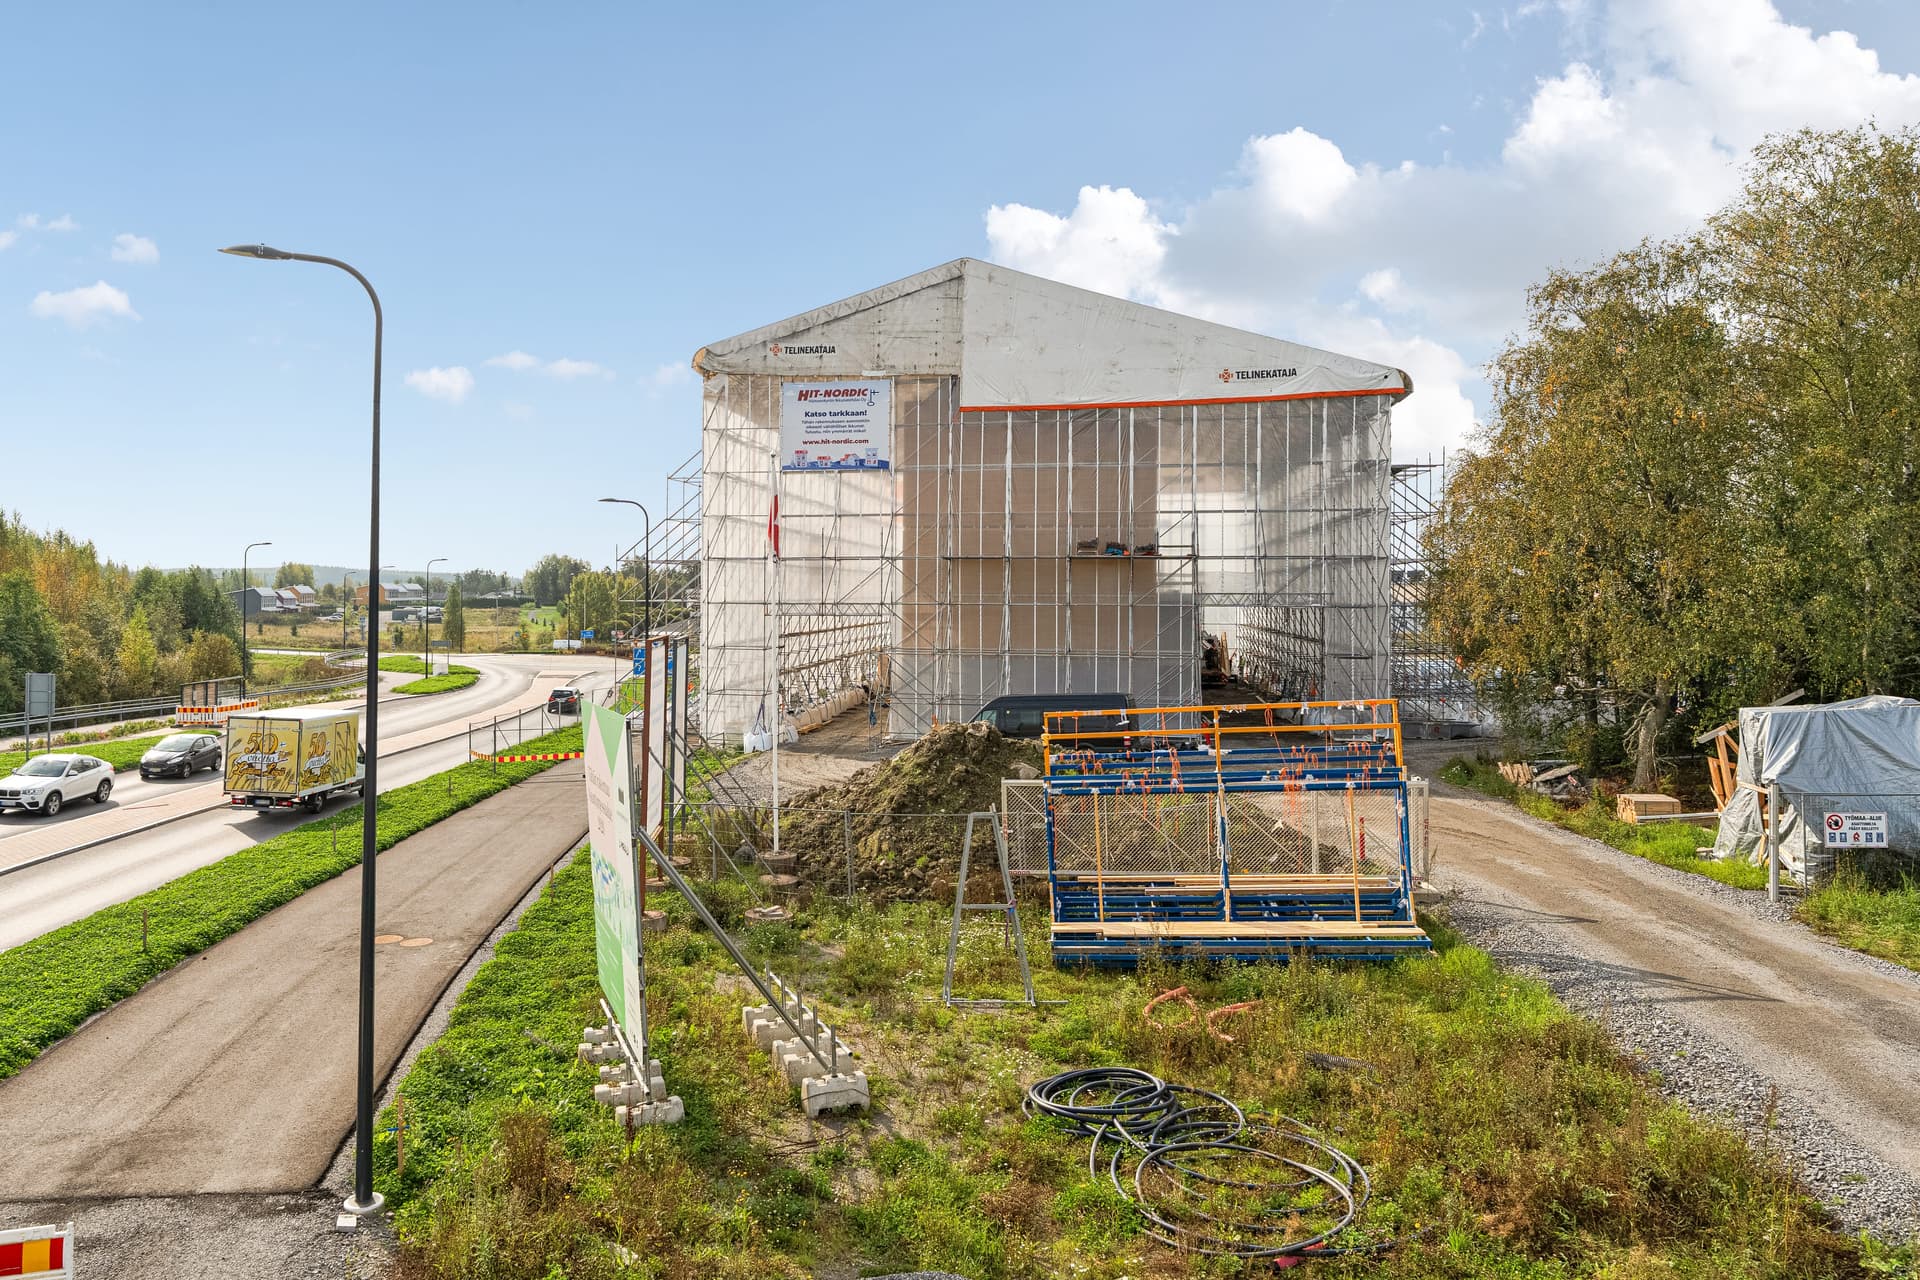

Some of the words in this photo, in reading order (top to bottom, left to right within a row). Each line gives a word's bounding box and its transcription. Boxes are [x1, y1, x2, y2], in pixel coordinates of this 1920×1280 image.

[784, 345, 836, 354] TELINEKATAJA
[1235, 368, 1297, 379] TELINEKATAJA
[797, 388, 869, 401] HIT-NORDIC
[802, 437, 869, 445] www.hit-nordic.com
[244, 732, 279, 754] 50
